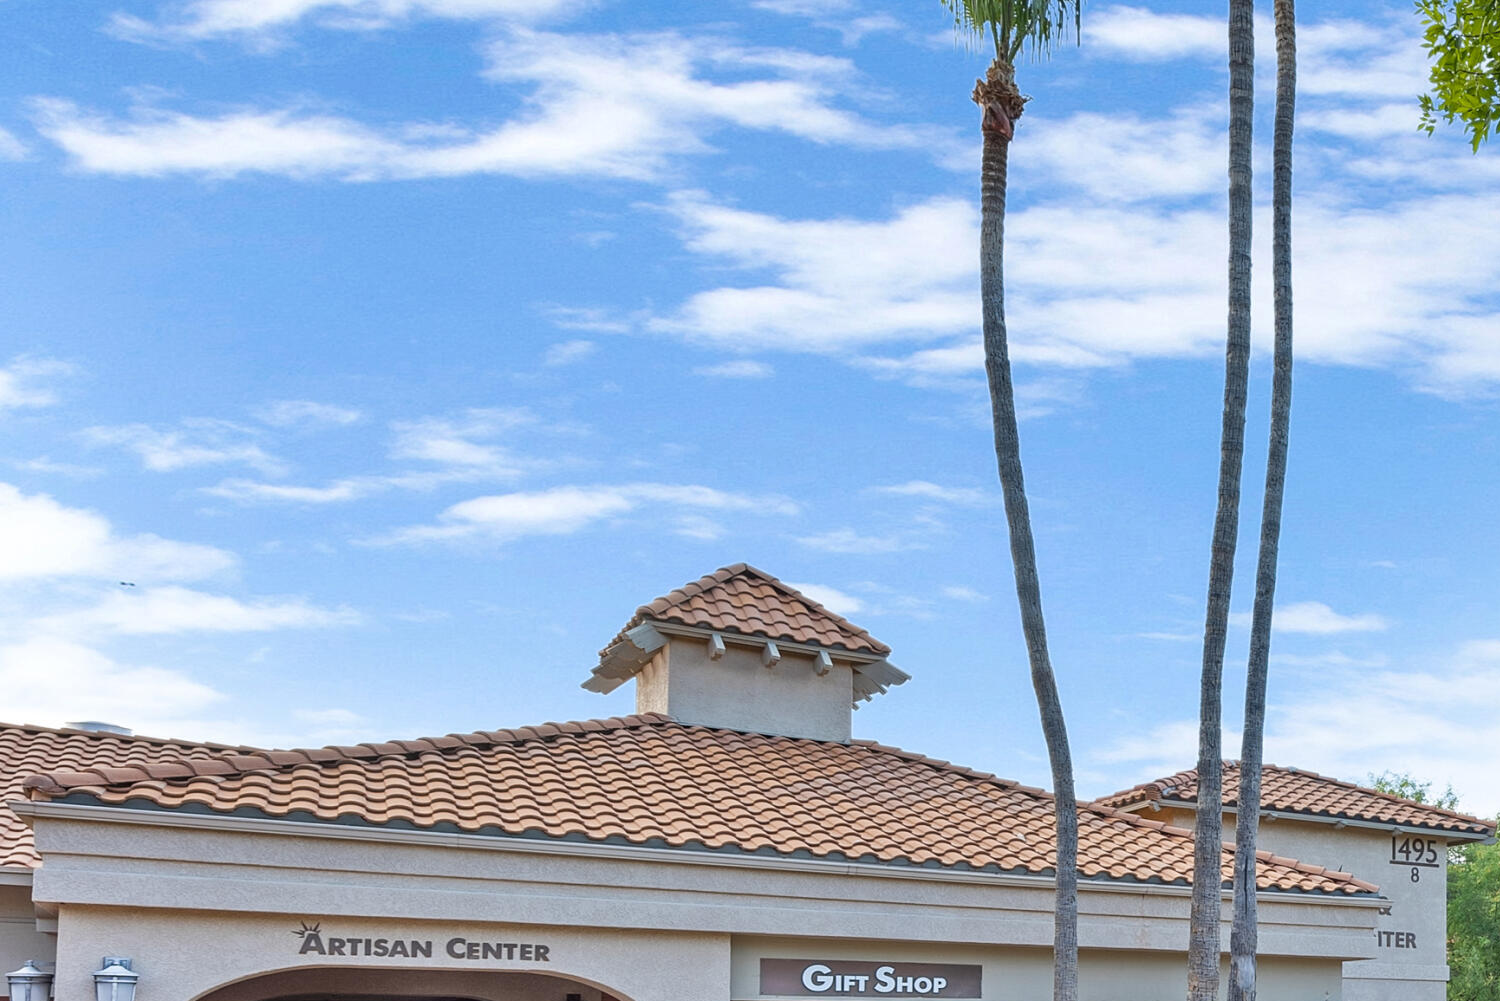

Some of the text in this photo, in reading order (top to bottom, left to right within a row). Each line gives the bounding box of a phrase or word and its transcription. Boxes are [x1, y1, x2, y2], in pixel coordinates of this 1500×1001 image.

[1391, 836, 1438, 864] 1495
[1410, 867, 1420, 883] 8
[298, 932, 551, 962] ARTISAN CENTER
[801, 964, 948, 994] GIFT SHOP
